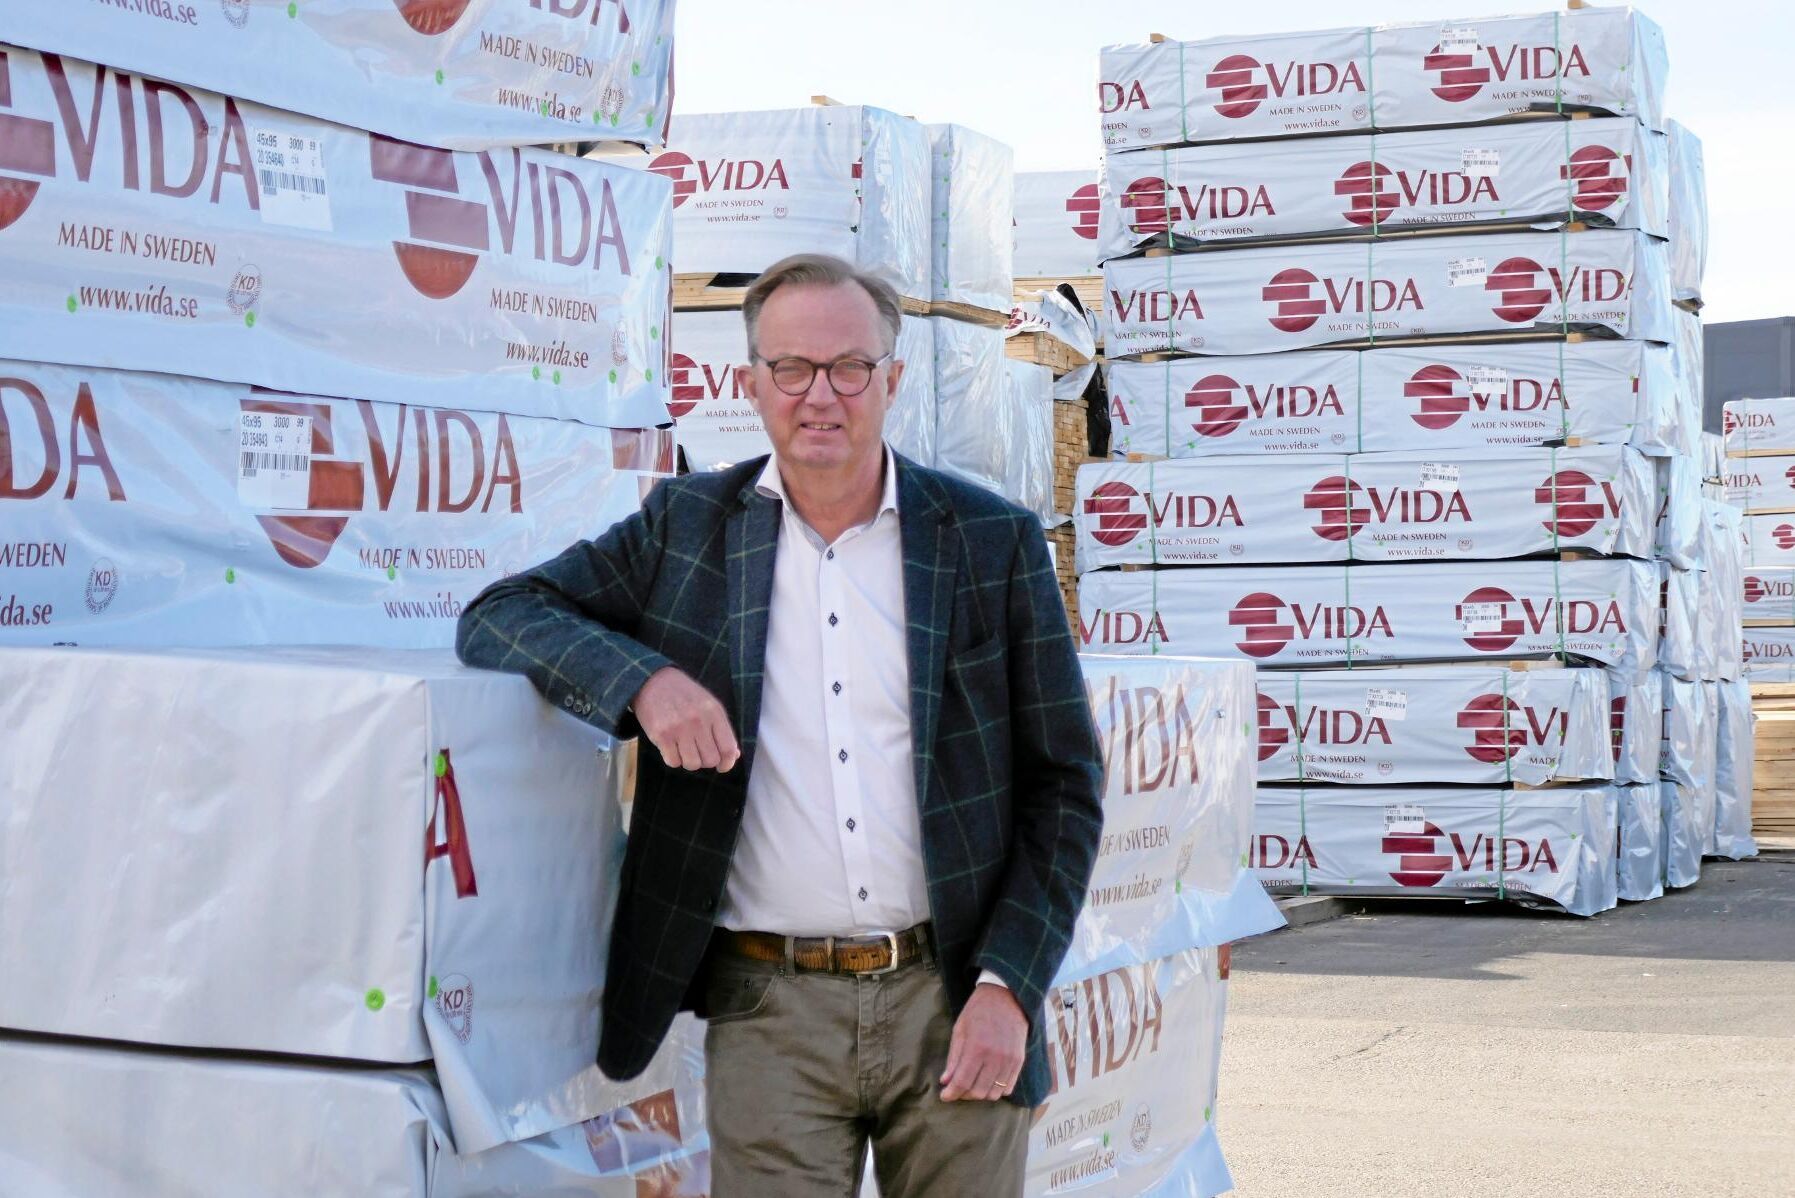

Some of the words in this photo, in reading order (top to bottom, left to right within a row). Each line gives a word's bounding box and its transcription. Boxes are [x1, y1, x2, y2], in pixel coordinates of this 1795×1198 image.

[480, 30, 521, 60] MADE
[525, 42, 537, 64] IN
[540, 47, 594, 79] SWEDEN
[1486, 44, 1590, 82] VIDA
[1264, 61, 1366, 98] VIDA
[498, 88, 582, 123] www.vidase
[1269, 107, 1295, 116] MADE
[1306, 104, 1342, 113] SWEDEN
[40, 51, 259, 211] VIDA
[1284, 118, 1340, 131] www.vida.se
[697, 159, 790, 192] VIDA
[1396, 169, 1500, 206] VIDA
[477, 147, 631, 276] VIDA
[1177, 184, 1276, 221] VIDA
[58, 222, 113, 252] MADE
[121, 231, 138, 255] IN
[143, 234, 217, 267] SWEDEN
[80, 285, 198, 319] www.vida.se
[490, 288, 528, 313] MADE
[532, 291, 544, 315] IN
[547, 297, 597, 323] SWEDEN
[1110, 289, 1205, 323] VIDA
[1323, 277, 1424, 314] VIDA
[1553, 313, 1578, 321] MDE
[506, 340, 589, 368] www.vida.se
[701, 363, 747, 400] VI
[1111, 394, 1131, 426] A
[1244, 383, 1344, 419] VIDA
[1250, 428, 1275, 437] MADE
[1286, 426, 1321, 435] SWEDEN
[1471, 421, 1497, 430] MADE
[1510, 420, 1546, 429] SWEDEN
[1735, 413, 1776, 428] VIDA
[1264, 439, 1319, 450] www.vida.se
[1486, 434, 1544, 444] www.vida.se
[356, 400, 523, 513] VIDA
[1143, 491, 1244, 528] VIDA
[1367, 486, 1472, 523] VIDA
[1372, 533, 1398, 542] MADE
[1411, 532, 1446, 541] SWEDEN
[1387, 545, 1445, 556] www.vida.se
[359, 548, 401, 568] MADE
[407, 549, 421, 568] IN
[426, 549, 485, 569] SWEDEN
[1163, 549, 1219, 560] www.vida.se
[95, 571, 110, 587] KD
[1764, 581, 1795, 596] VID
[1080, 608, 1169, 645] VIDA
[1290, 603, 1395, 640] VIDA
[1520, 598, 1627, 635] VIDA
[1335, 648, 1369, 656] SWDEN
[1751, 642, 1793, 658] VIDA
[1083, 675, 1199, 801] VIDA
[1284, 705, 1393, 745] VIDA
[1305, 769, 1364, 779] www.vida.se
[1329, 755, 1366, 763] SWEDEN
[426, 748, 478, 898] A
[1449, 832, 1560, 873] VIDA
[444, 989, 464, 1010] KD
[1050, 961, 1163, 1089] VIDA
